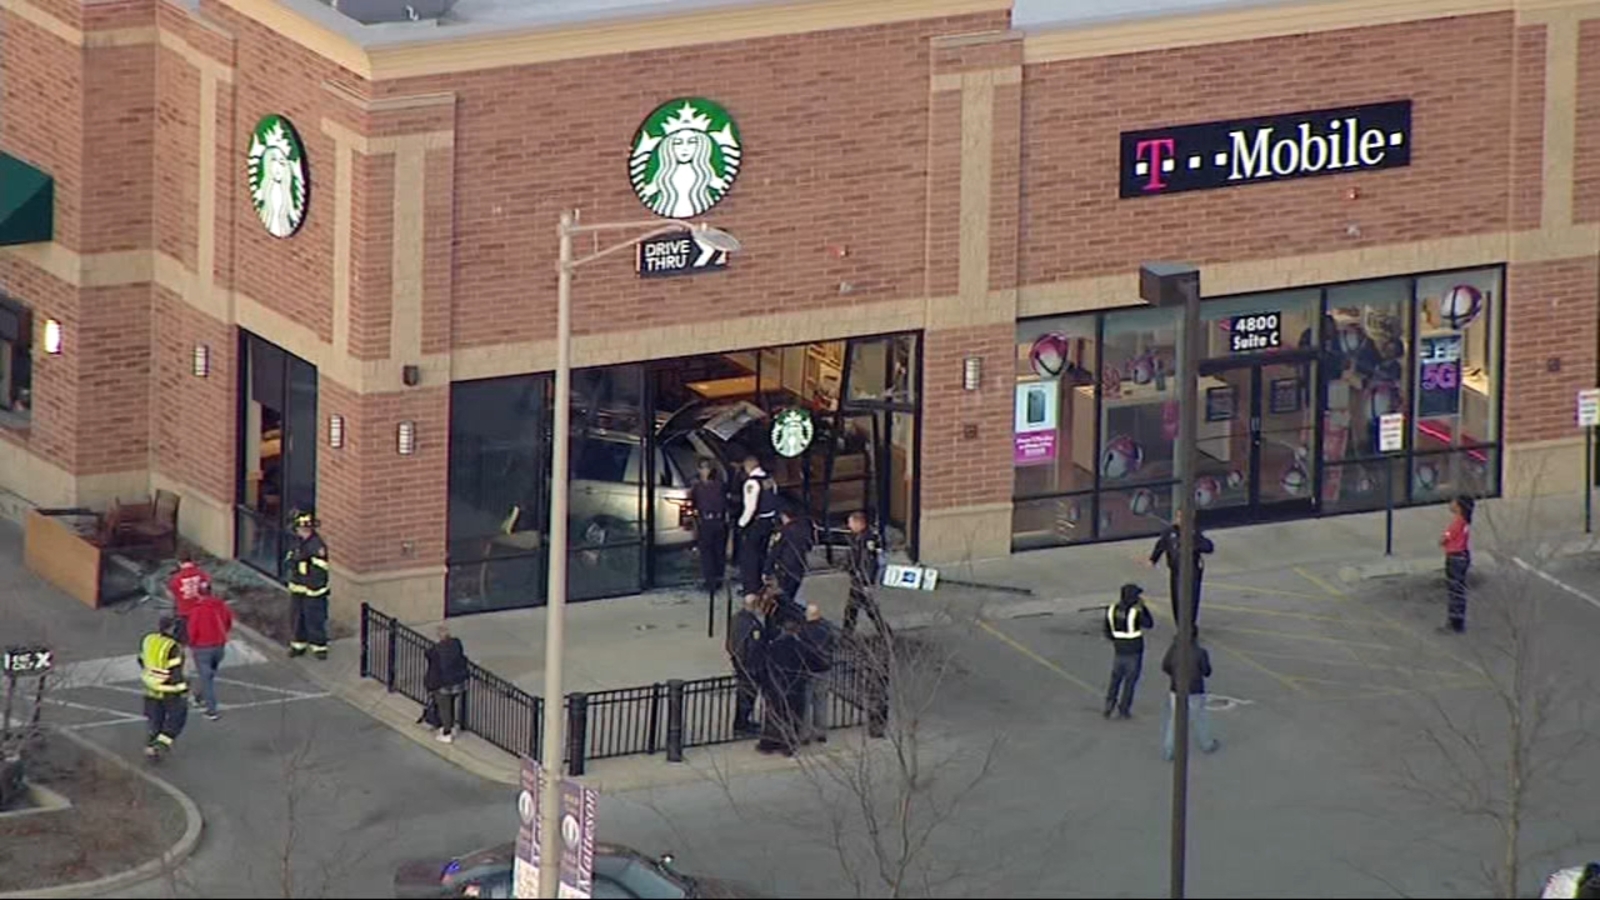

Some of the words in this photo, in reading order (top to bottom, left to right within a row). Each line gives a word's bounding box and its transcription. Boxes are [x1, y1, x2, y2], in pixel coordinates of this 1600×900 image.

[644, 239, 691, 257] DRIVE
[645, 254, 687, 271] THRU
[1235, 314, 1278, 332] 4800
[1233, 333, 1268, 350] Suite
[1270, 331, 1279, 345] C
[1422, 362, 1458, 390] 5G
